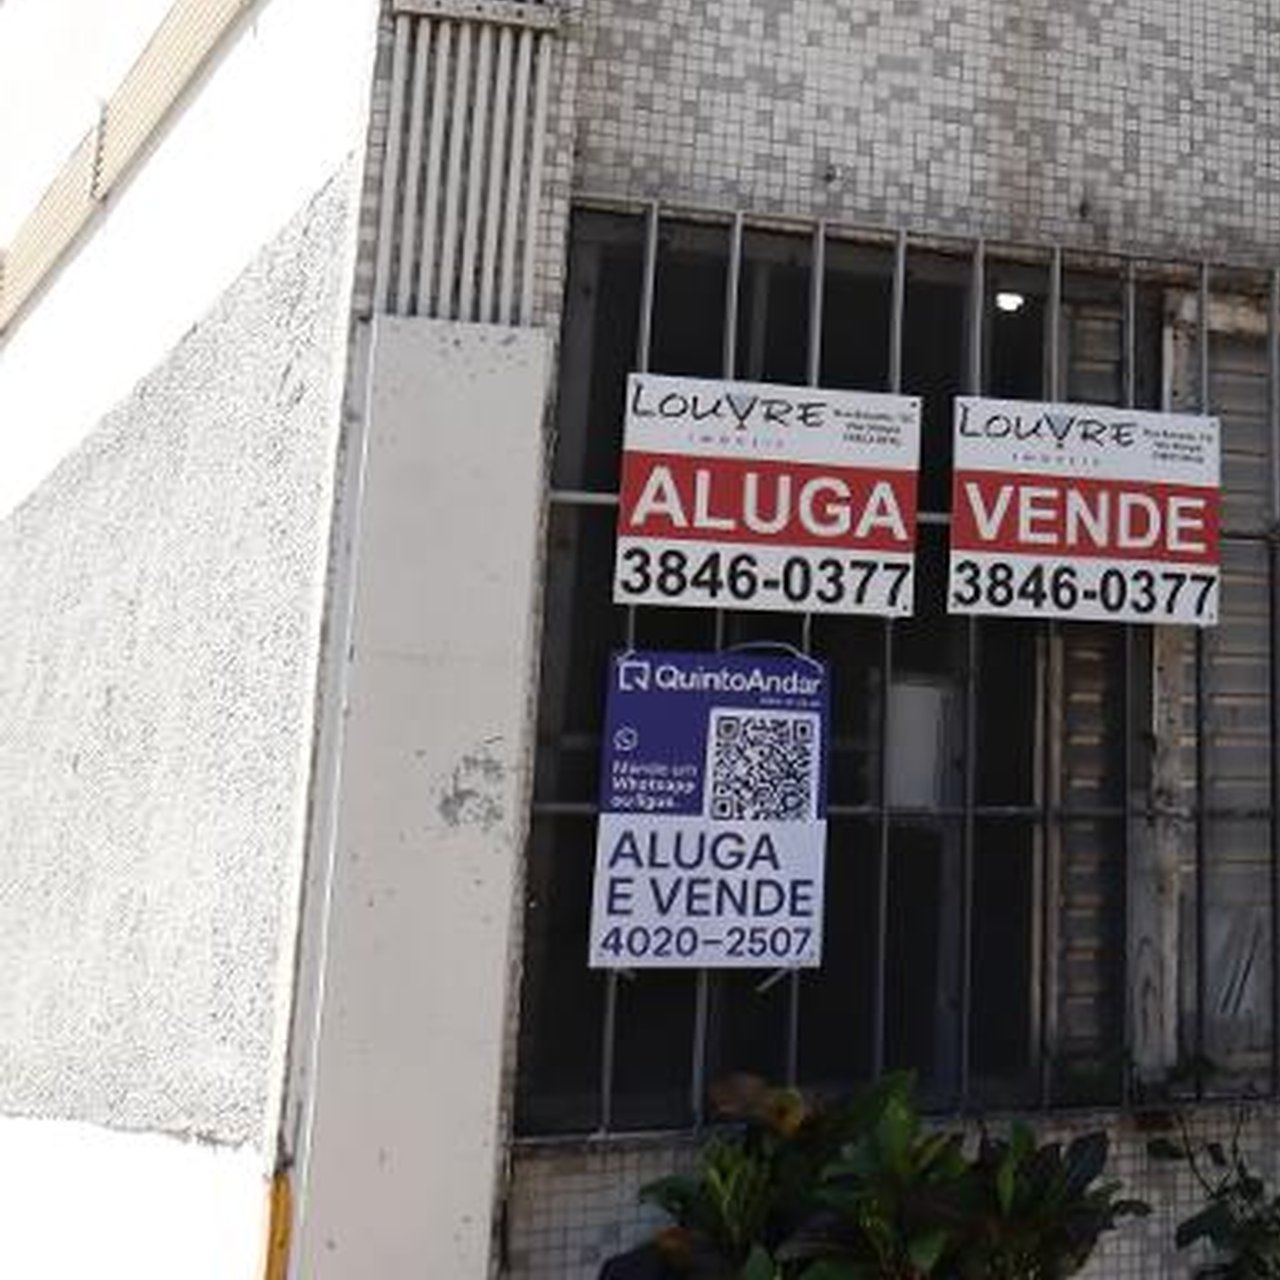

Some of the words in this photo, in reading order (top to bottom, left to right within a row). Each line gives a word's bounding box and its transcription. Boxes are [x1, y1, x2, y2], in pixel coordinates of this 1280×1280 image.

[630, 465, 909, 541] ALUGA
[963, 482, 1208, 553] VENDE
[620, 547, 911, 607] 3846-0377
[954, 560, 1217, 616] 3846-0377
[655, 665, 821, 695] QuintoAndar
[608, 829, 780, 872] ALUGA
[606, 877, 637, 917] E
[650, 877, 815, 918] VENDE
[600, 925, 813, 958] 4020-2507
